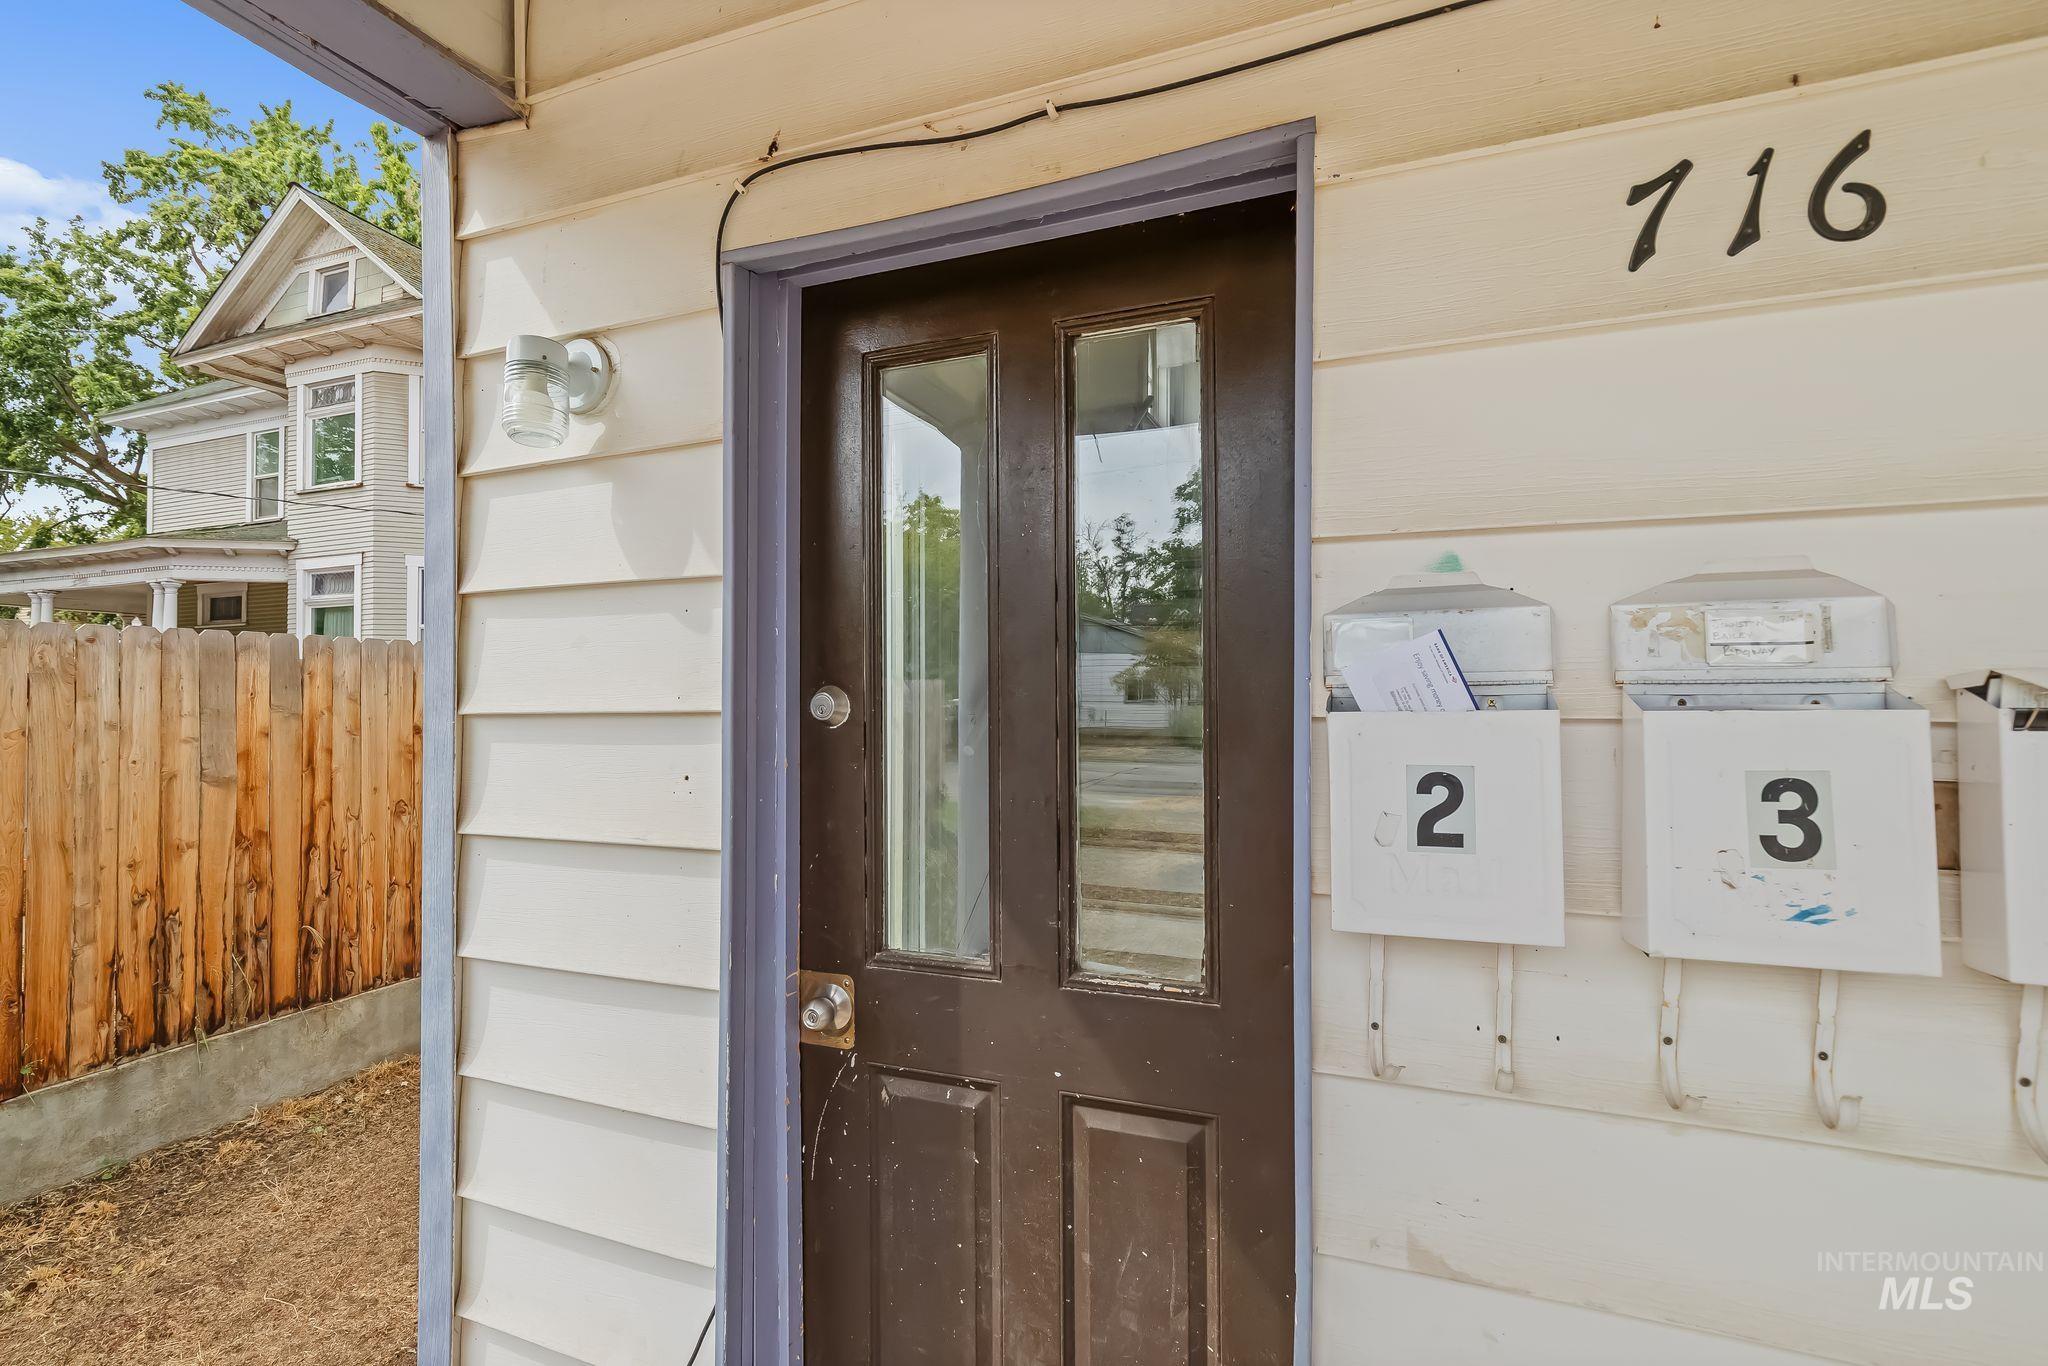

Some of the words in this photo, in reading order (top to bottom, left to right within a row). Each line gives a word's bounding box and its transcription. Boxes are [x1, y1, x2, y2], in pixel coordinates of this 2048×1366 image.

[1626, 128, 1887, 272] 716
[1412, 652, 1423, 669] Enjoy
[1422, 669, 1434, 689] saving
[1430, 687, 1443, 708] money
[1441, 658, 1452, 677] AMERICA
[1416, 771, 1464, 848] 2
[1759, 777, 1822, 862] 3
